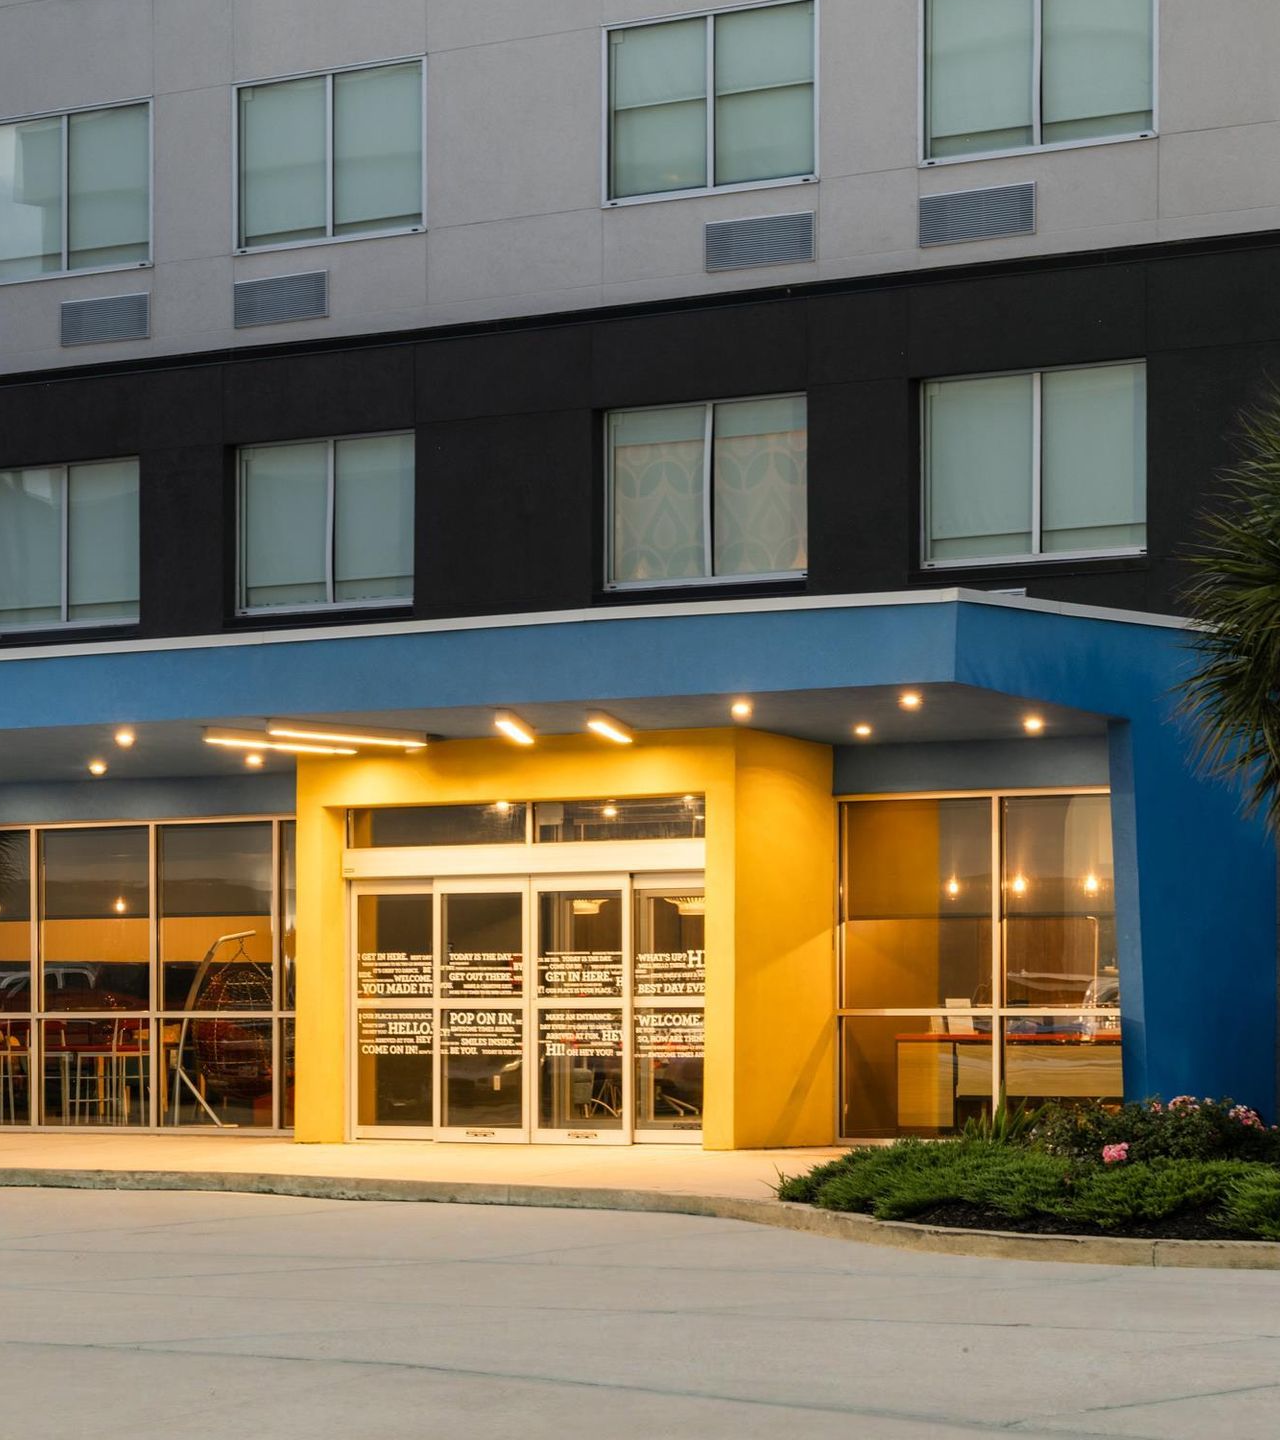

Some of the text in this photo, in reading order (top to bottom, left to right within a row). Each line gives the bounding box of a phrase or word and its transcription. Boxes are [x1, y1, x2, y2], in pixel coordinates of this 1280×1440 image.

[361, 952, 377, 961] GET
[377, 952, 386, 961] IN
[449, 952, 473, 961] TODAY
[474, 952, 481, 961] IS
[482, 952, 497, 961] THE
[638, 953, 687, 962] WHAT'S UP?
[393, 974, 433, 983] WELCOME.
[448, 972, 465, 981] GET
[466, 972, 484, 981] OUT
[484, 972, 514, 981] THERE.
[545, 971, 613, 982] GET IN HERE.
[362, 983, 433, 994] YOU MADE IT!
[638, 983, 663, 994] BEST
[663, 983, 685, 994] DAY
[449, 1012, 516, 1025] POP ON IN.
[545, 1013, 565, 1021] MAKE
[638, 1014, 704, 1027] WELCOME.
[388, 1022, 433, 1035] HELLO.
[461, 1037, 516, 1046] SMILES INSIDE.
[362, 1045, 418, 1055] COME ON IN!
[449, 1047, 460, 1055] BE
[545, 1043, 565, 1056] HI!
[566, 1048, 579, 1057] OH
[579, 1048, 594, 1057] HEY
[594, 1048, 614, 1057] YOU!
